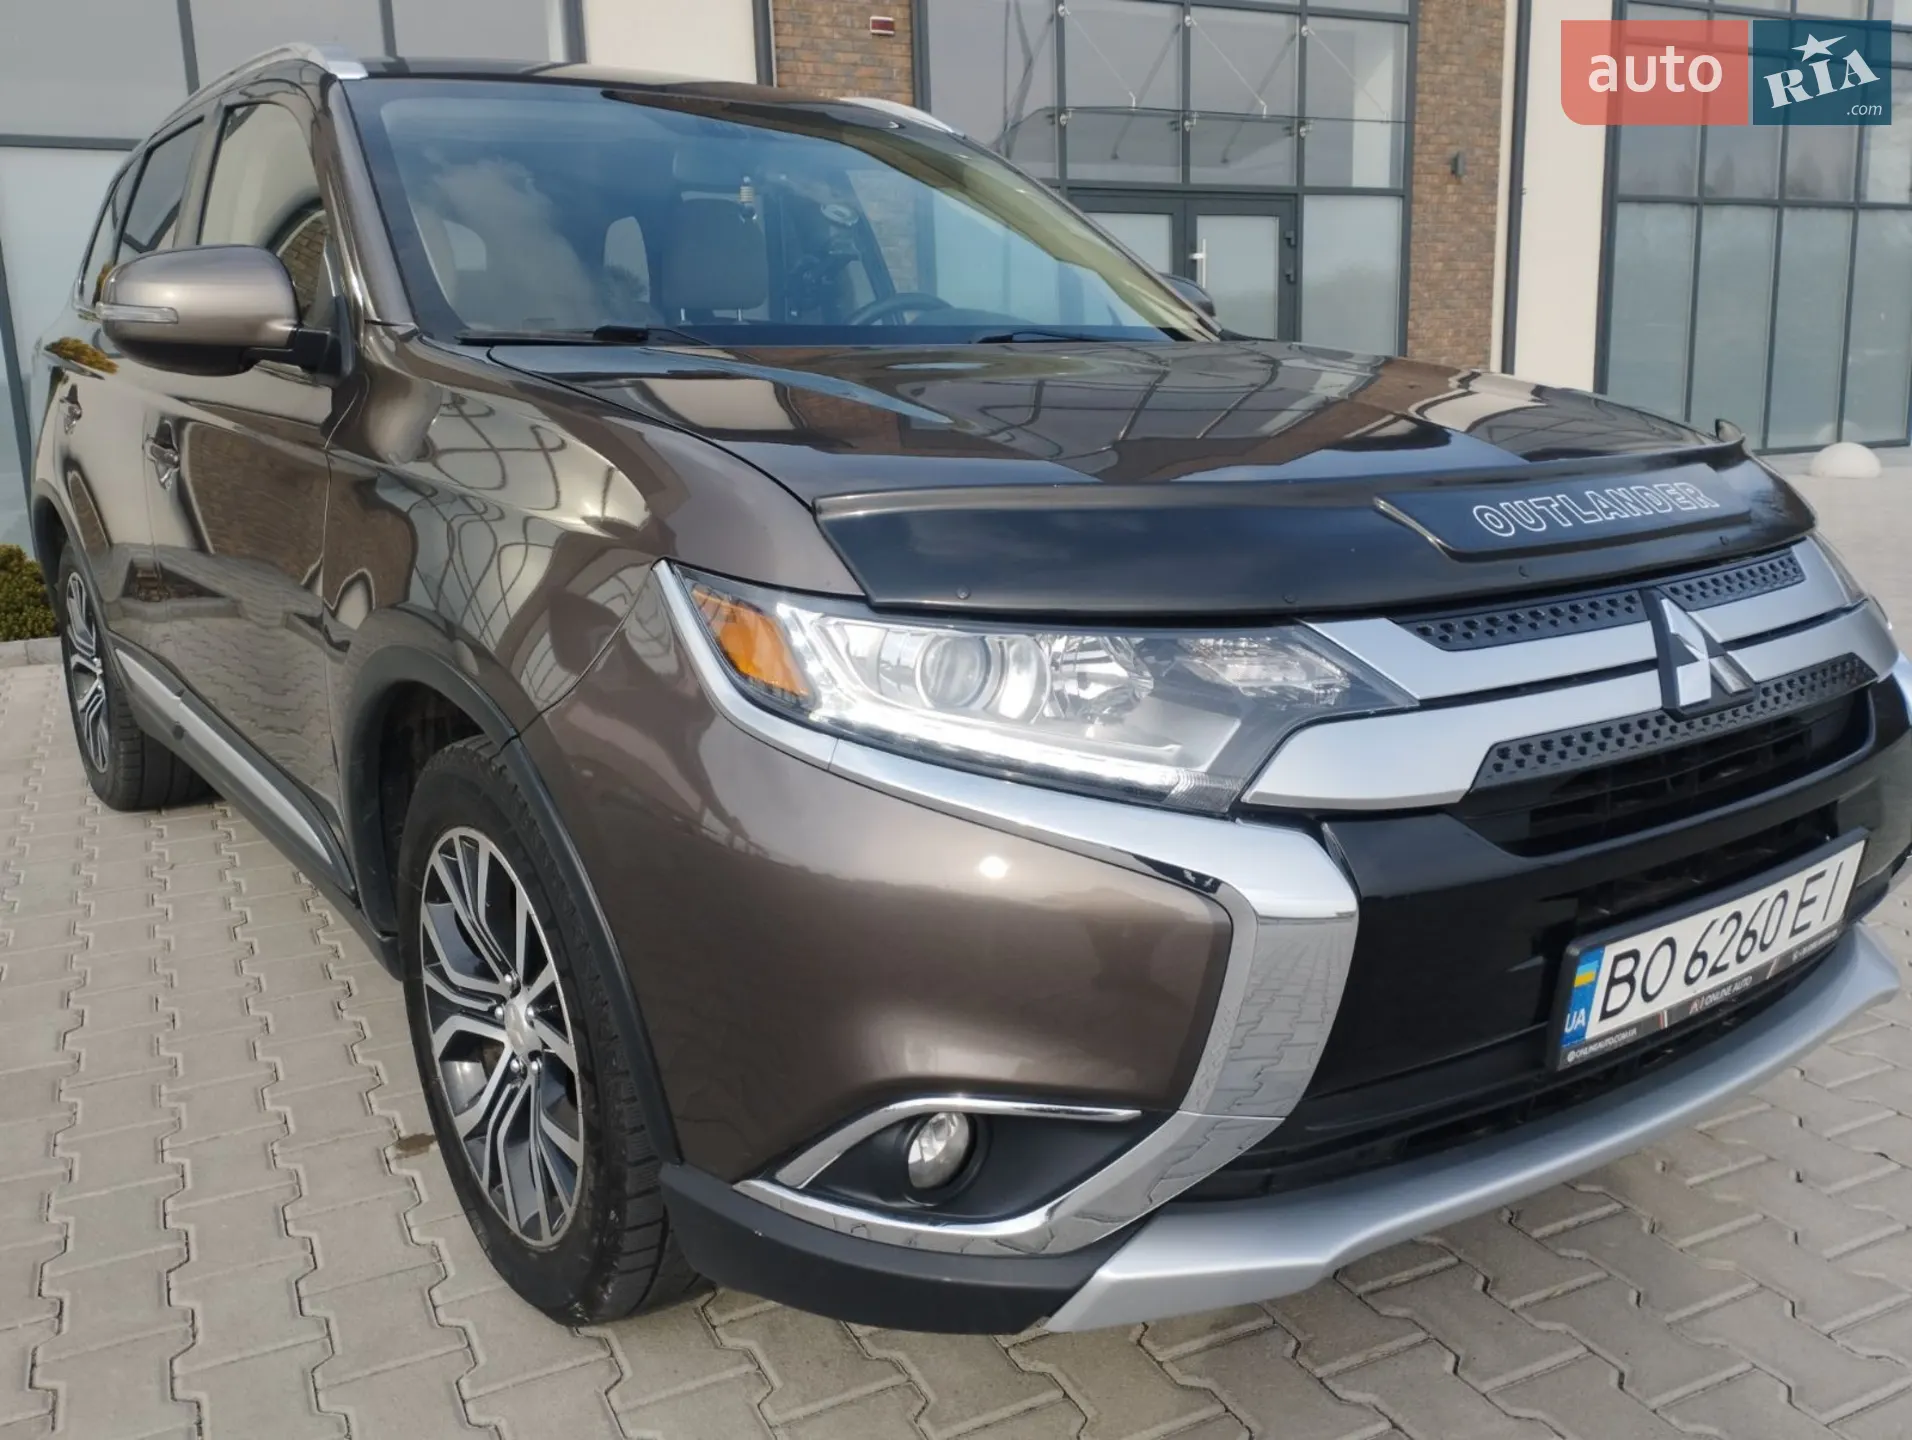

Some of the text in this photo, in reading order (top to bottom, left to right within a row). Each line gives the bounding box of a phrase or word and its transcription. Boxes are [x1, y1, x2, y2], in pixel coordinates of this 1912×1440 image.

[1473, 482, 1720, 537] OUTLANDER
[1598, 860, 1844, 1024] BO 6260 EI
[1564, 1007, 1586, 1034] UA
